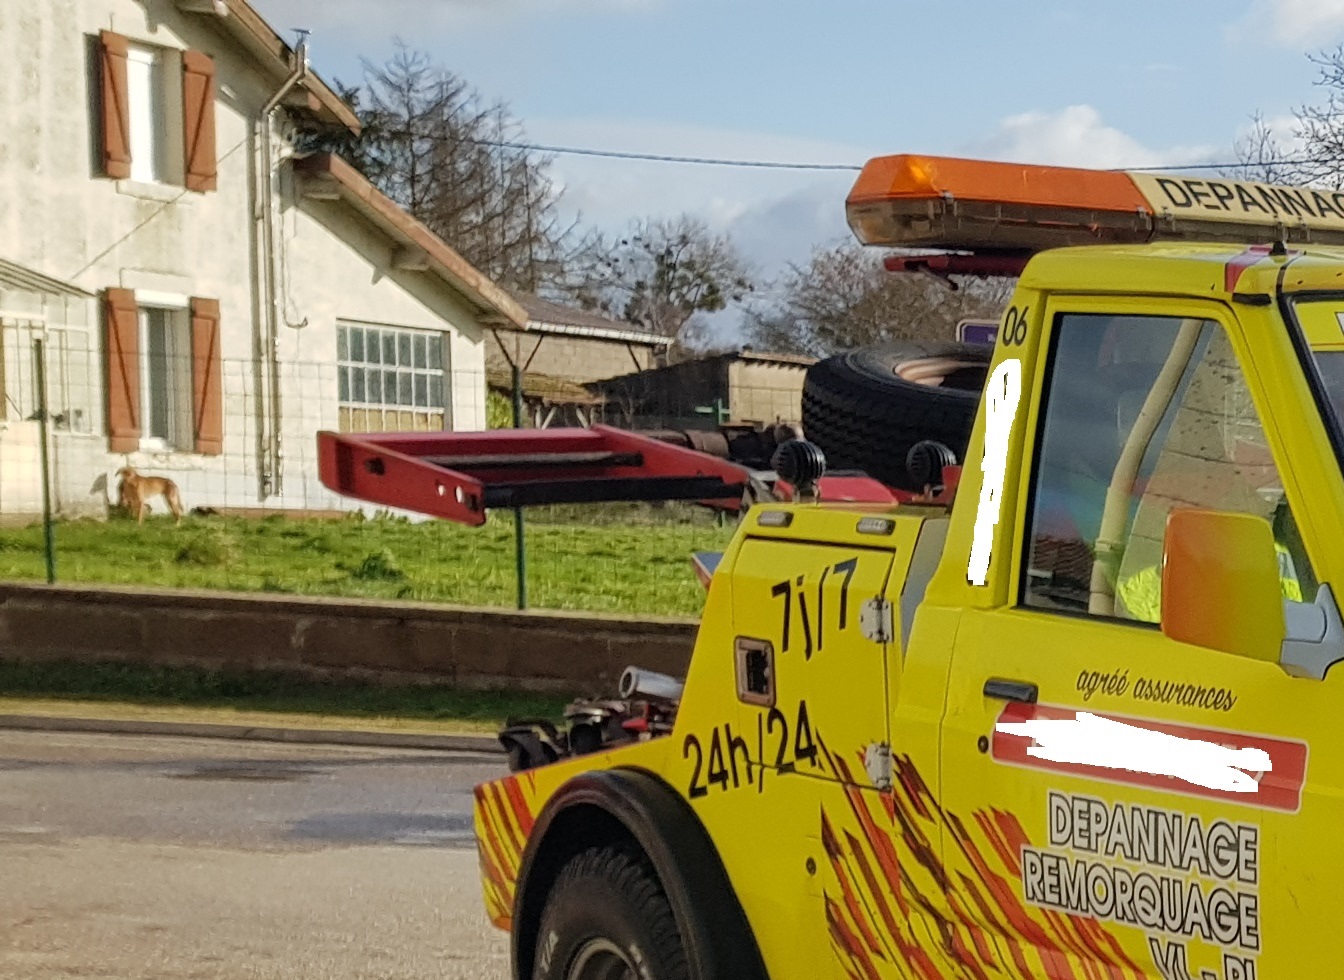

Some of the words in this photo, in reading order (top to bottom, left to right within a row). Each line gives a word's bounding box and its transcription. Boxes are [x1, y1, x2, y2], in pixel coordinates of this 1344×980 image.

[1002, 306, 1030, 346] 06
[771, 557, 857, 661] 7j/7
[1076, 668, 1130, 701] agréé
[1133, 677, 1238, 712] assurances
[683, 700, 819, 799] 24h/24
[1048, 792, 1259, 884] DEPANNAGE
[1022, 847, 1260, 951] REMORQUAGE
